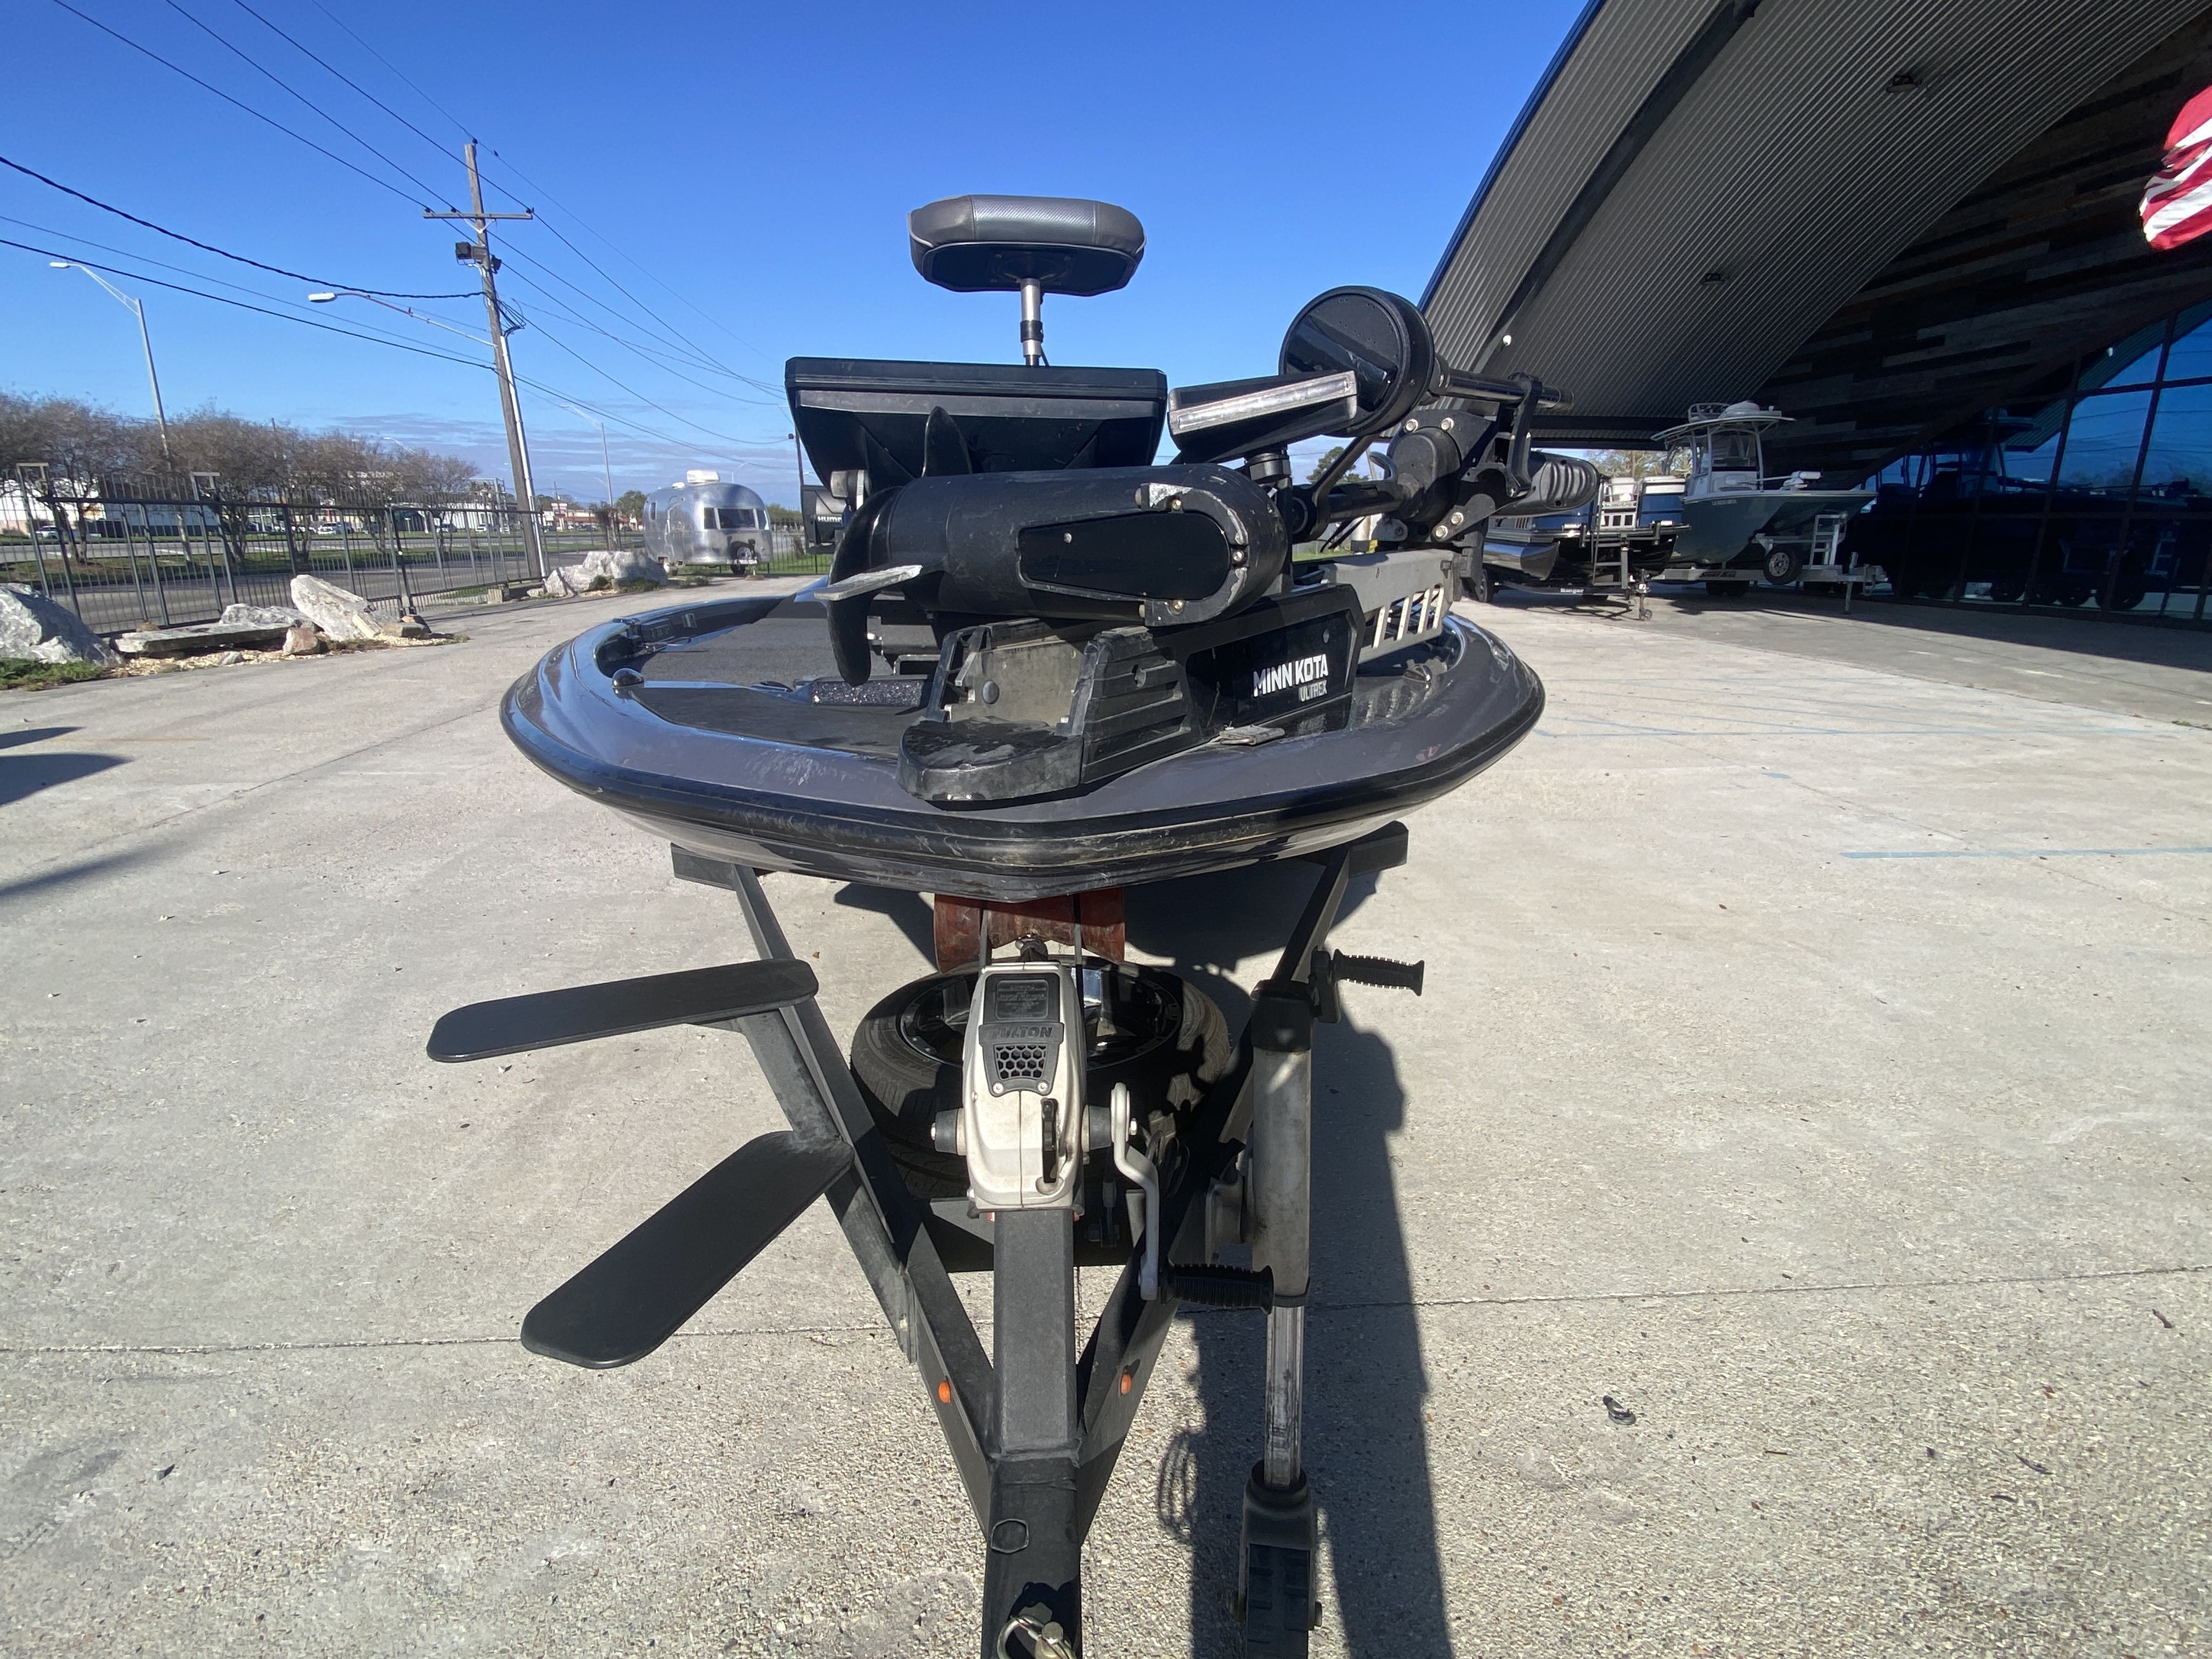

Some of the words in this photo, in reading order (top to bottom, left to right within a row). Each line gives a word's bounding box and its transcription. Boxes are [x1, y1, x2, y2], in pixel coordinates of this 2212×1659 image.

[1253, 662, 1293, 697] MINN
[1295, 653, 1328, 685] KOTA
[1298, 680, 1327, 702] ULTREX
[991, 1026, 1053, 1039] FULTON
